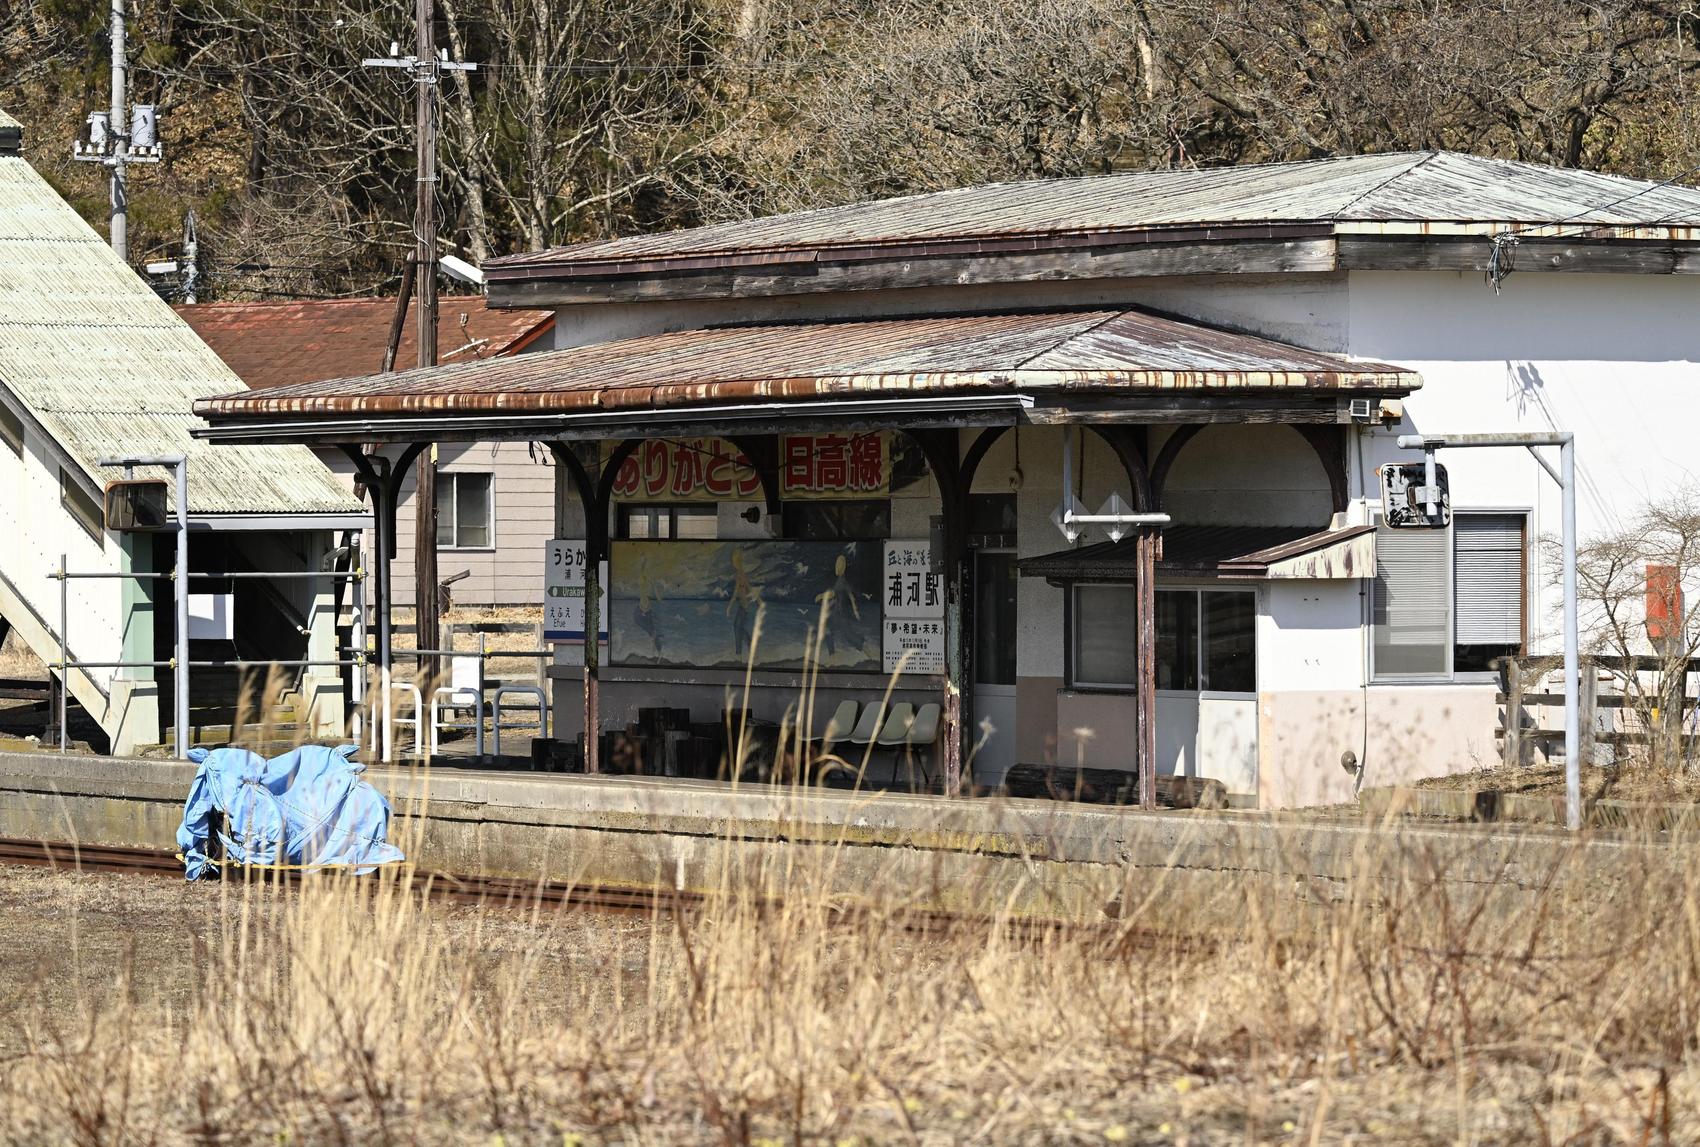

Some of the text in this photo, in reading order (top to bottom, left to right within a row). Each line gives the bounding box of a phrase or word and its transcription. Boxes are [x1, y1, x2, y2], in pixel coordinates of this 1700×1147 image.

[784, 433, 883, 491] 日高線
[554, 548, 587, 566] うらか
[562, 585, 585, 597] Urakaw
[888, 571, 939, 607] 浦河駅
